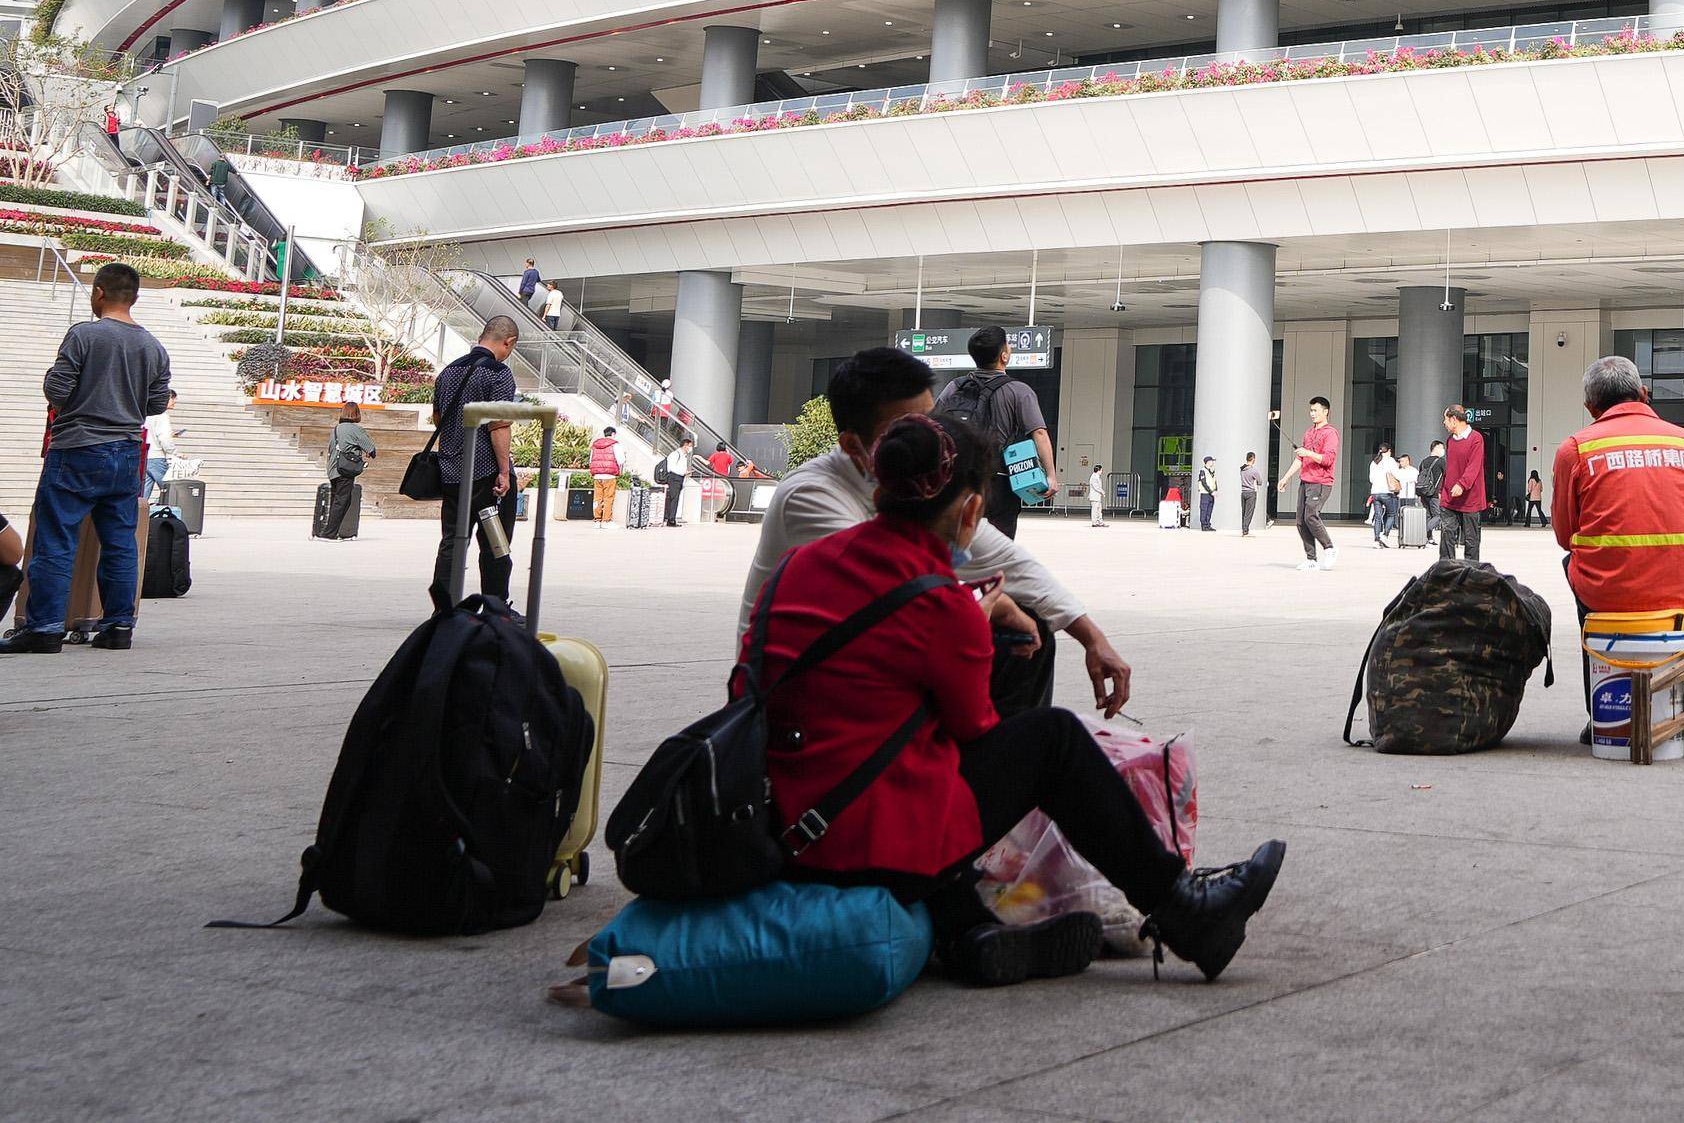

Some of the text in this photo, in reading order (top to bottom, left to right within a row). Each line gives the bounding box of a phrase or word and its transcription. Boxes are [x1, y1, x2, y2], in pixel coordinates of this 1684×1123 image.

[260, 379, 383, 404] 山水智慧城区
